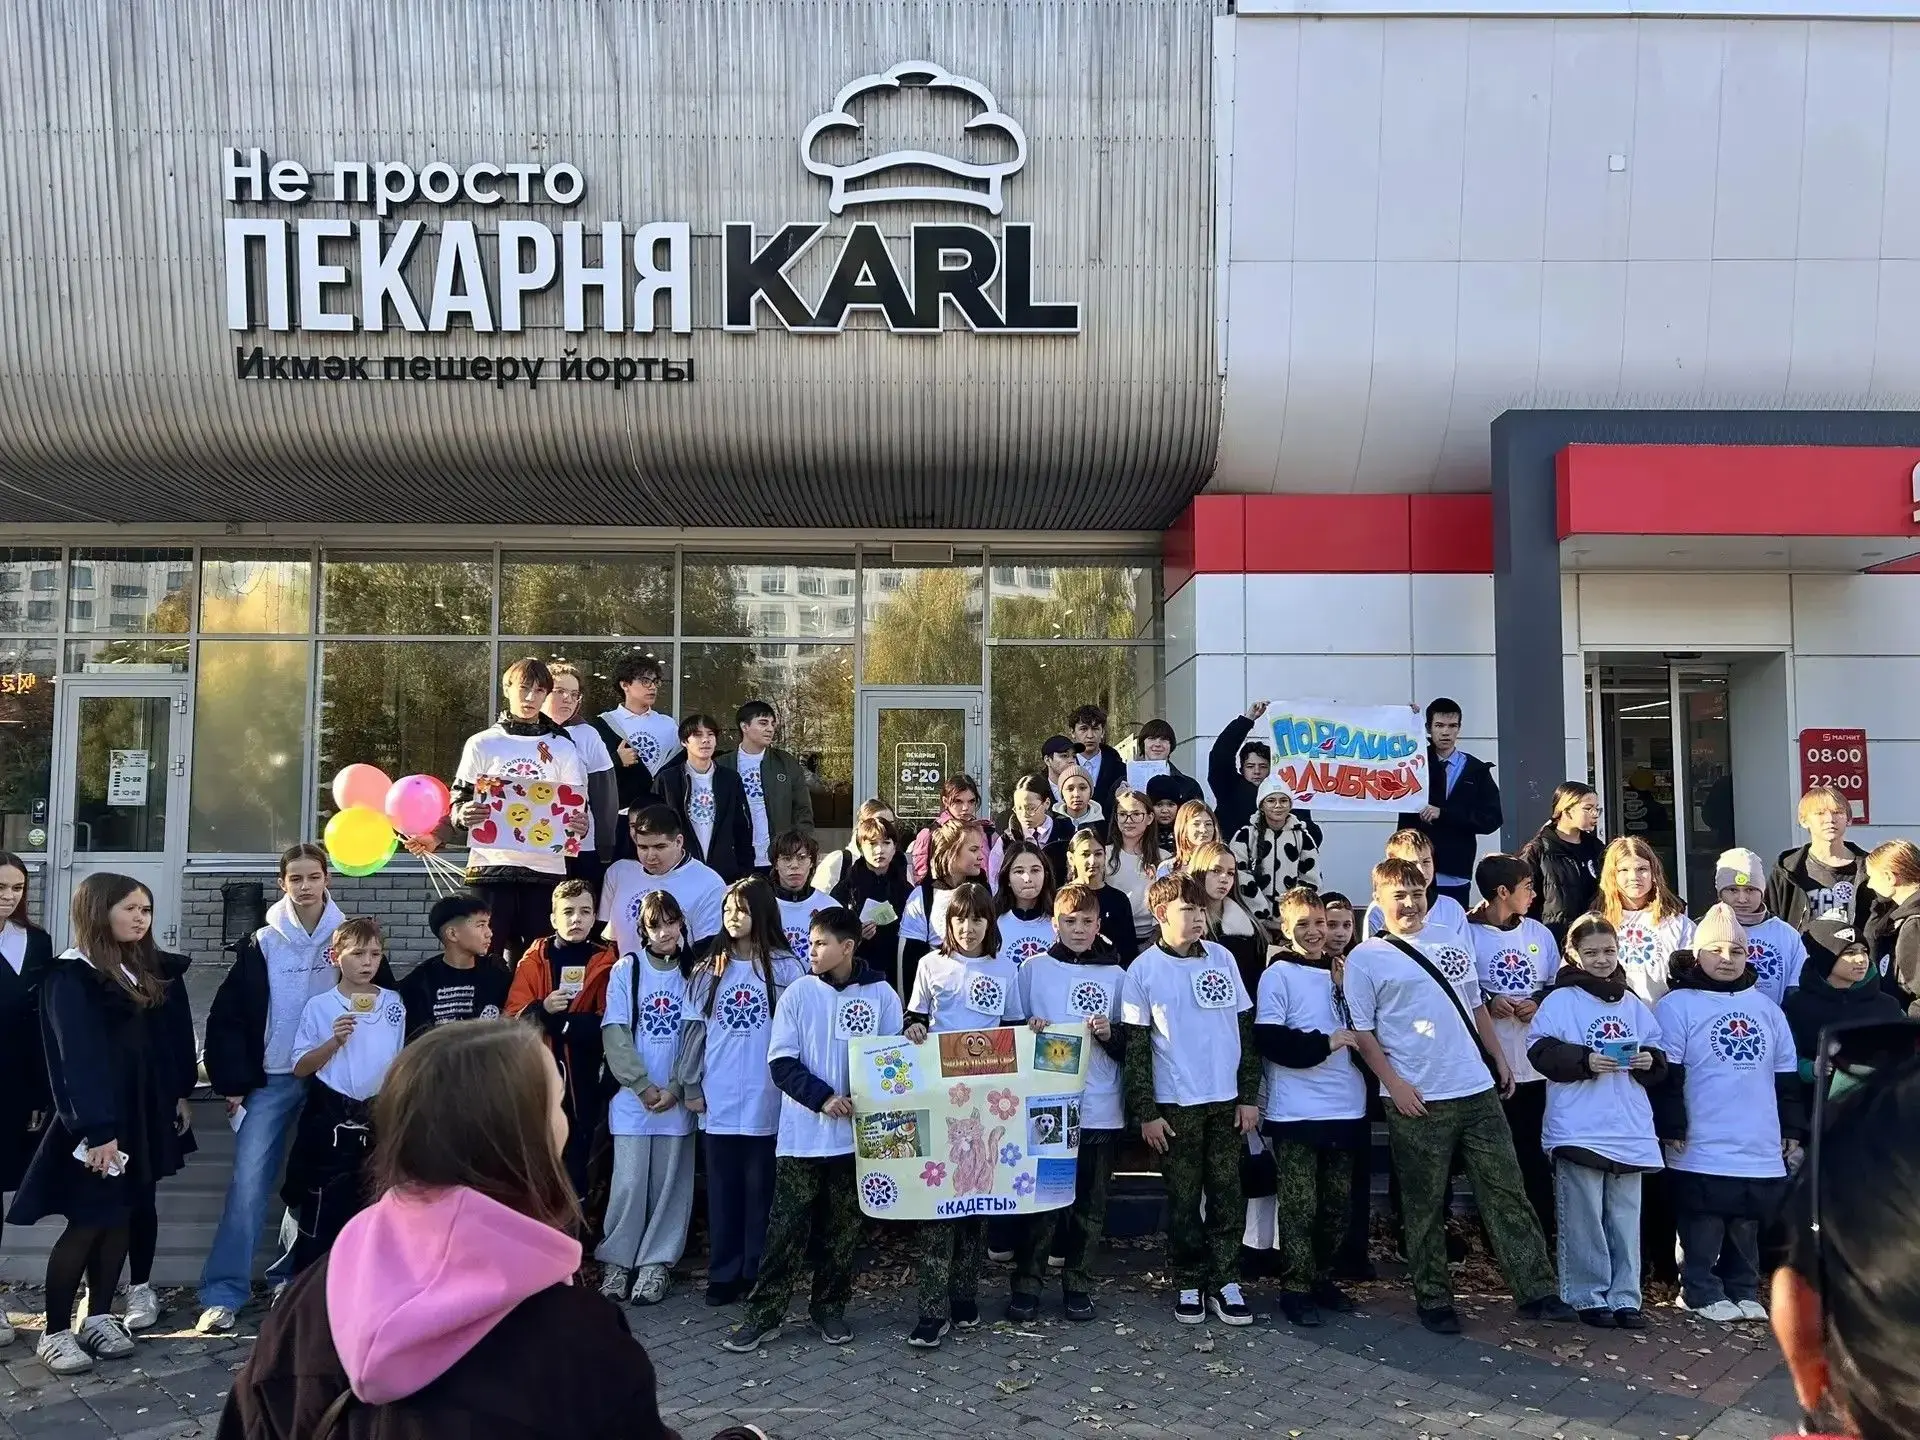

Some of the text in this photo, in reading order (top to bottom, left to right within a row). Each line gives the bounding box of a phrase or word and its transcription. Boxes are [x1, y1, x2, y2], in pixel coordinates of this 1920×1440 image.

[223, 147, 585, 216] Не просто
[224, 218, 692, 333] ПЕКАРНЯ
[723, 221, 1082, 334] KARL
[236, 347, 695, 389] Икмәк пешерү йорты
[901, 769, 940, 783] 8-20
[1809, 775, 1862, 788] 22:00
[937, 1197, 1017, 1215] «КАДЕТЫ»
